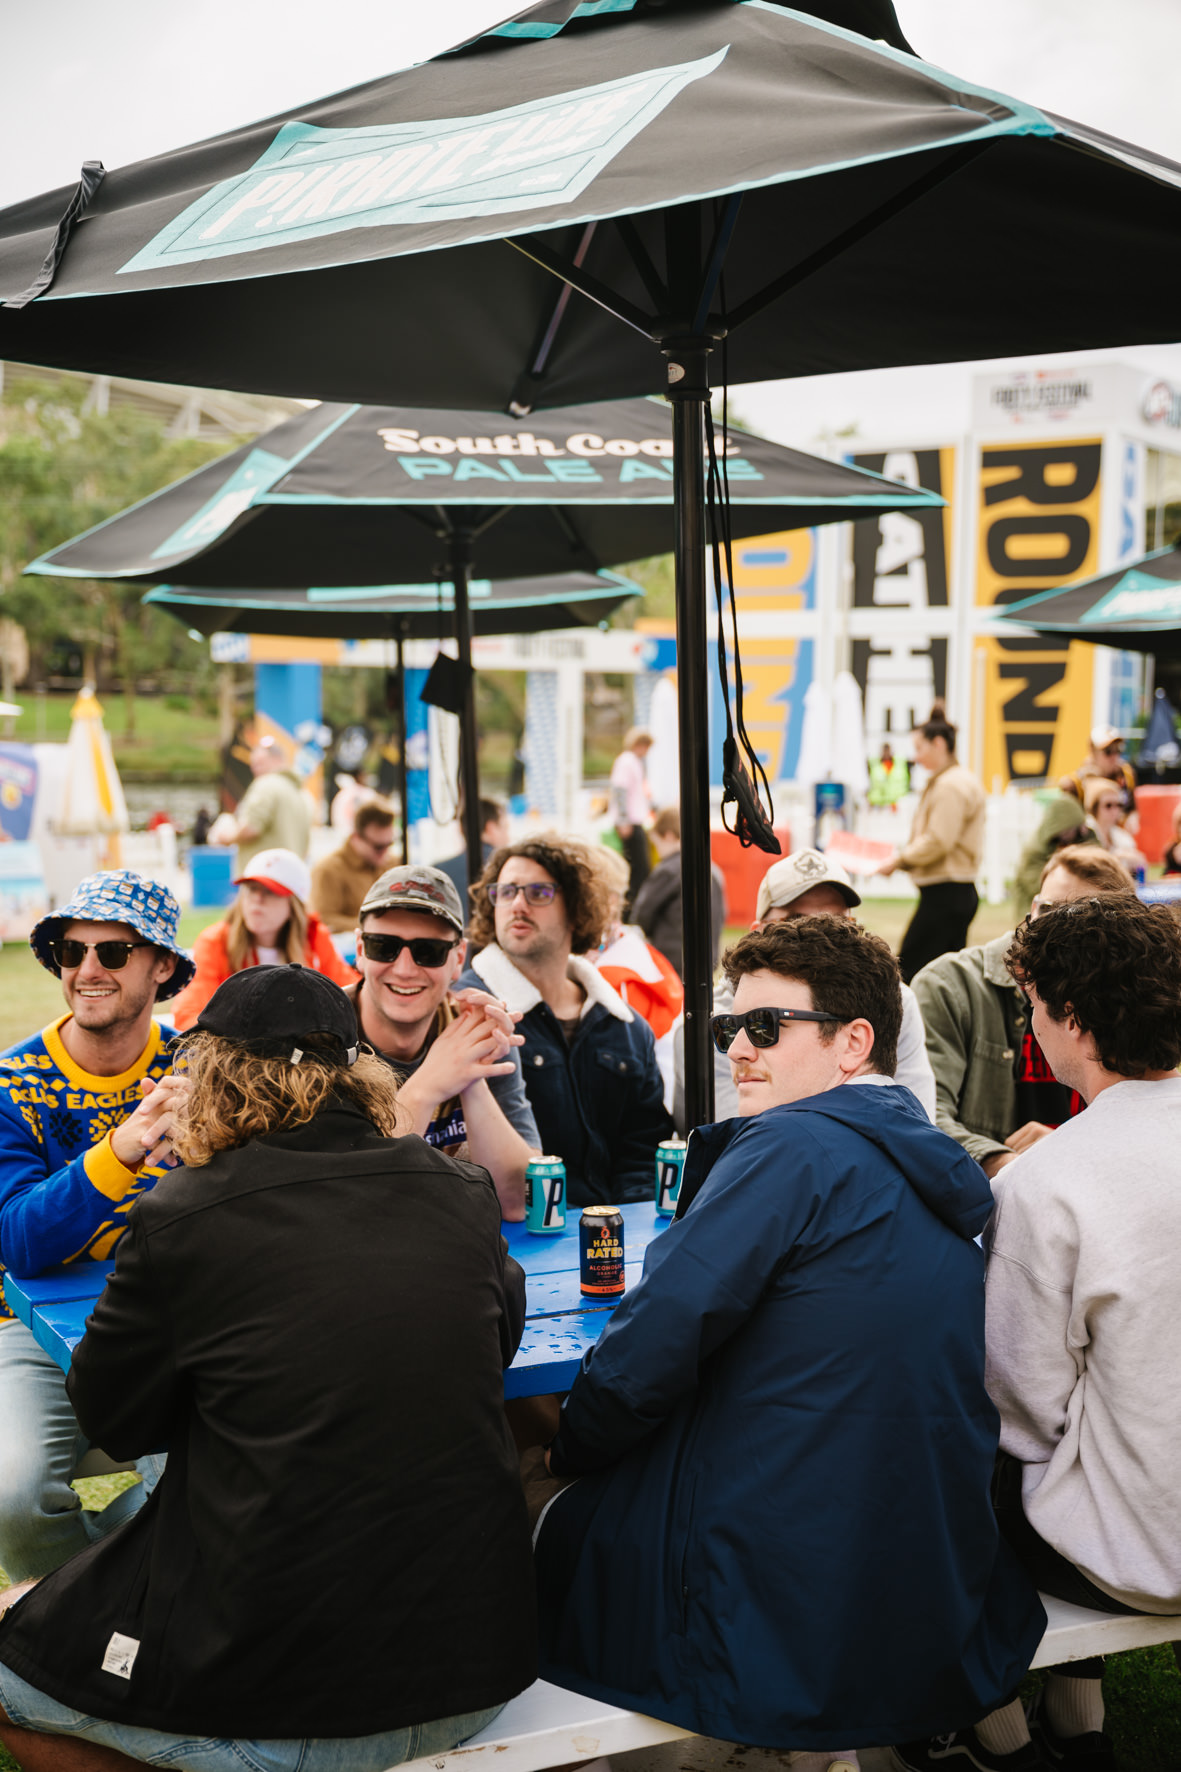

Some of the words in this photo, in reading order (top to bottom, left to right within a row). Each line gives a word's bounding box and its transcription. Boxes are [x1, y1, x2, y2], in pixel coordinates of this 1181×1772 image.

[377, 428, 566, 456] South
[565, 432, 741, 457] Coat
[397, 456, 604, 483] PALE
[618, 457, 765, 483] AE
[66, 1083, 146, 1110] EAGLES
[586, 1246, 624, 1260] RATED
[593, 1238, 619, 1248] HARD
[589, 1263, 623, 1272] ALCOHOLIC
